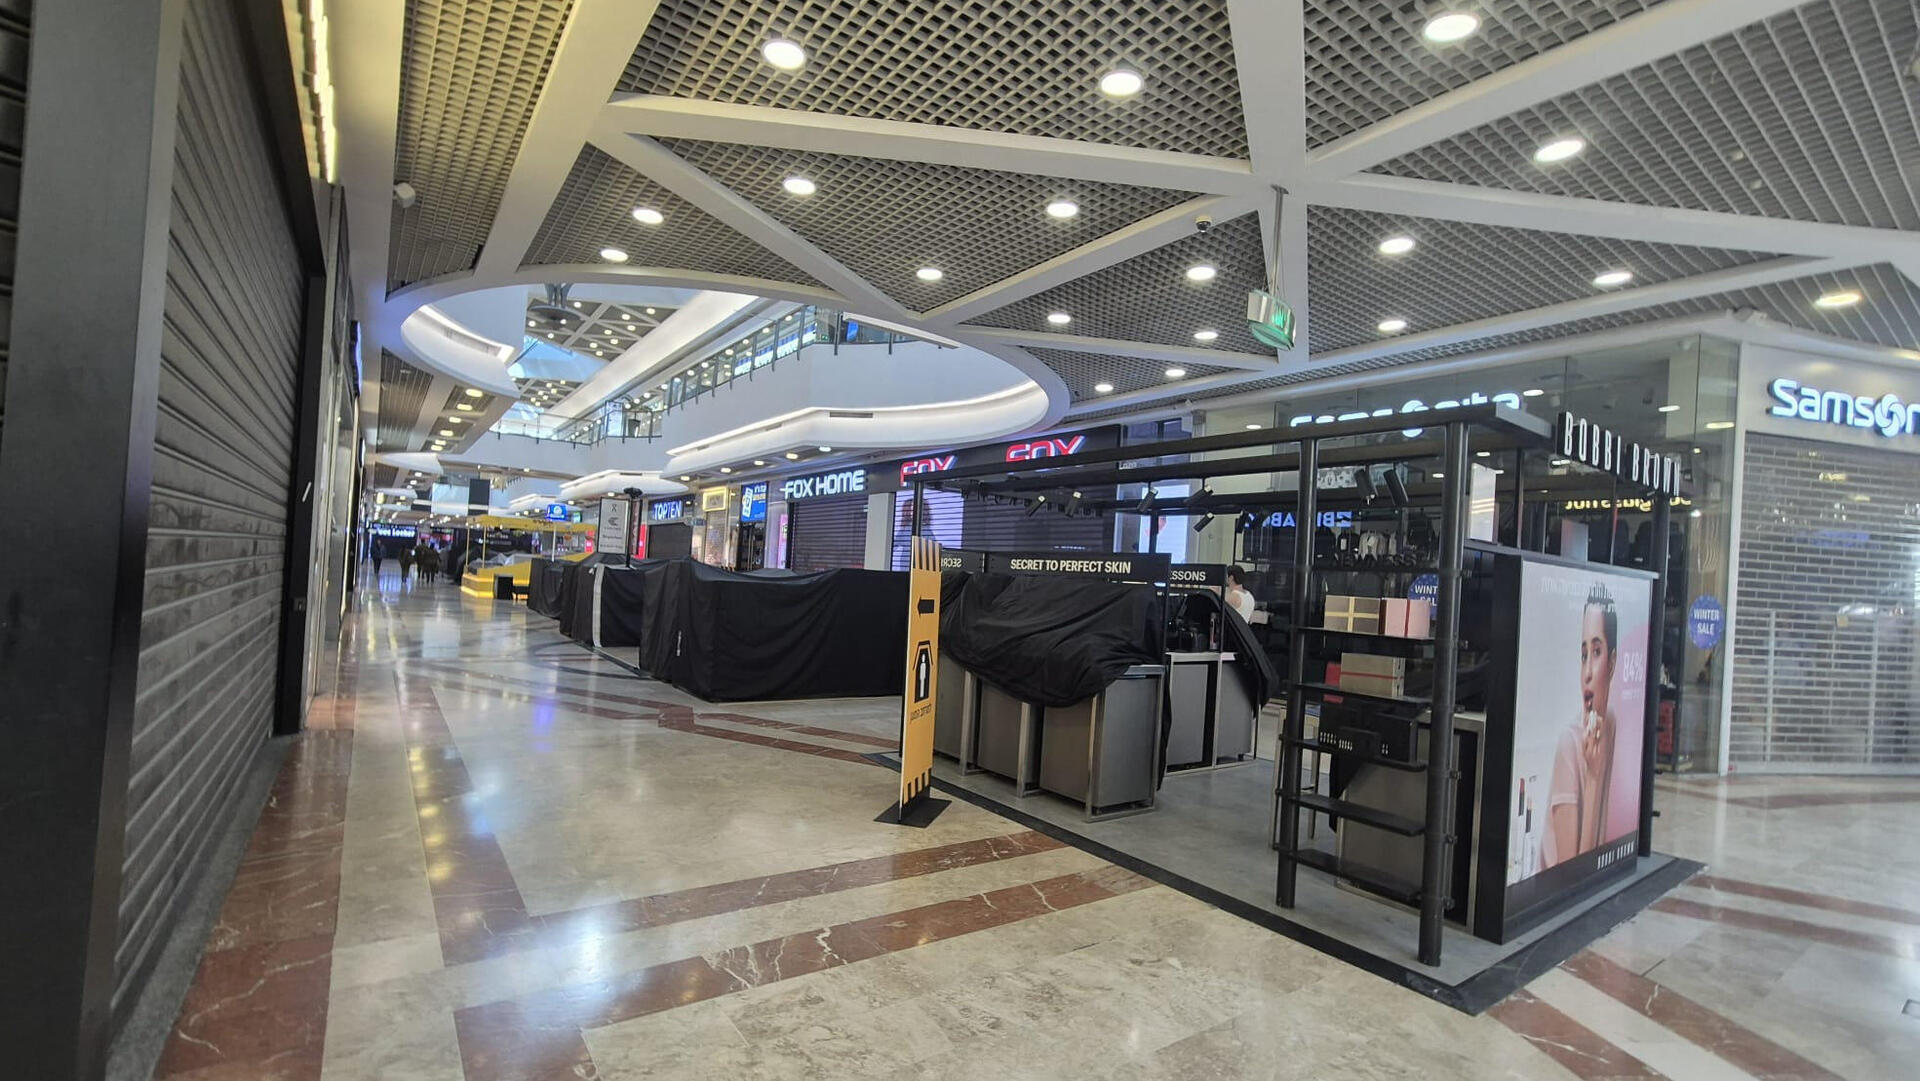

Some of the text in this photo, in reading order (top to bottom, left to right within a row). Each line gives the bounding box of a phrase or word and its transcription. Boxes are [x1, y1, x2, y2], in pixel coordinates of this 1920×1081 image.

[1564, 411, 1621, 476] BOBBI
[1632, 443, 1680, 497] BROWN
[780, 478, 814, 500] FOX
[815, 469, 865, 496] HOME
[1010, 558, 1131, 574] SECRET TO PERFECT SKIN
[1170, 570, 1206, 582] SSONS
[1414, 584, 1438, 595] WINT
[1692, 608, 1720, 621] WINTER
[1697, 622, 1715, 636] SALE
